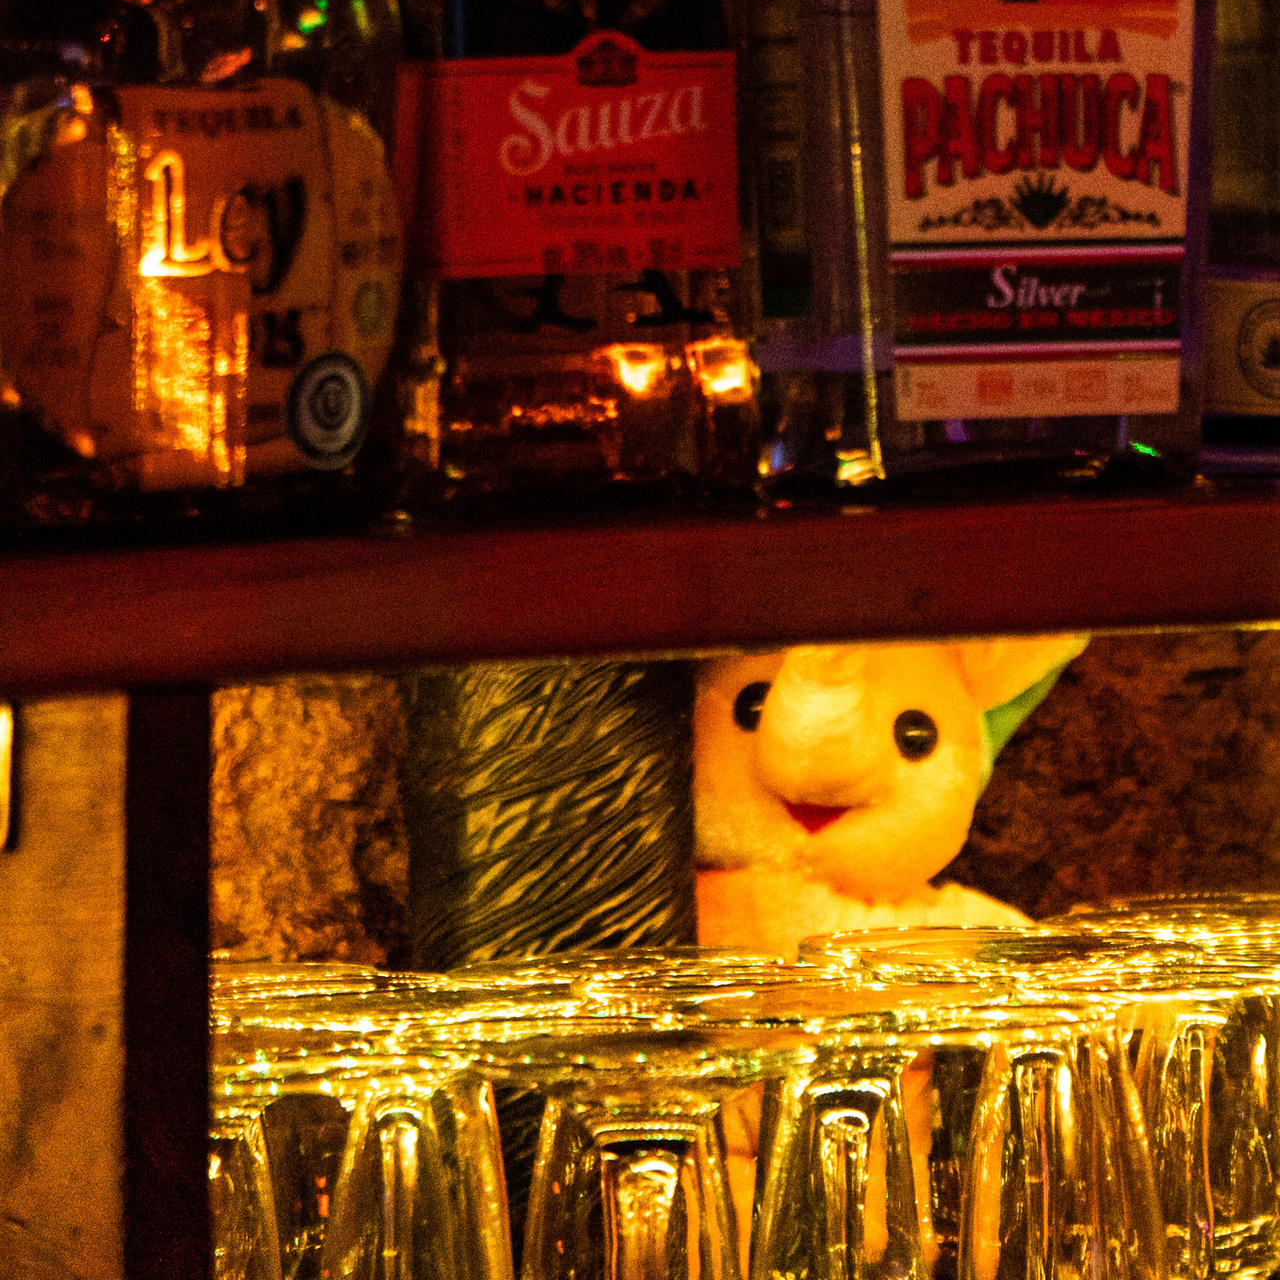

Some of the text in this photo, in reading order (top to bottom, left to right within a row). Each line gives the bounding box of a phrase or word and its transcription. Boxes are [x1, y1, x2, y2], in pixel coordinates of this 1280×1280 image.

[953, 29, 1122, 65] TEQUILA
[500, 79, 708, 176] Sauza
[901, 72, 1181, 200] PACHUCA
[524, 179, 699, 207] HACIENDA
[986, 264, 1087, 309] Silver
